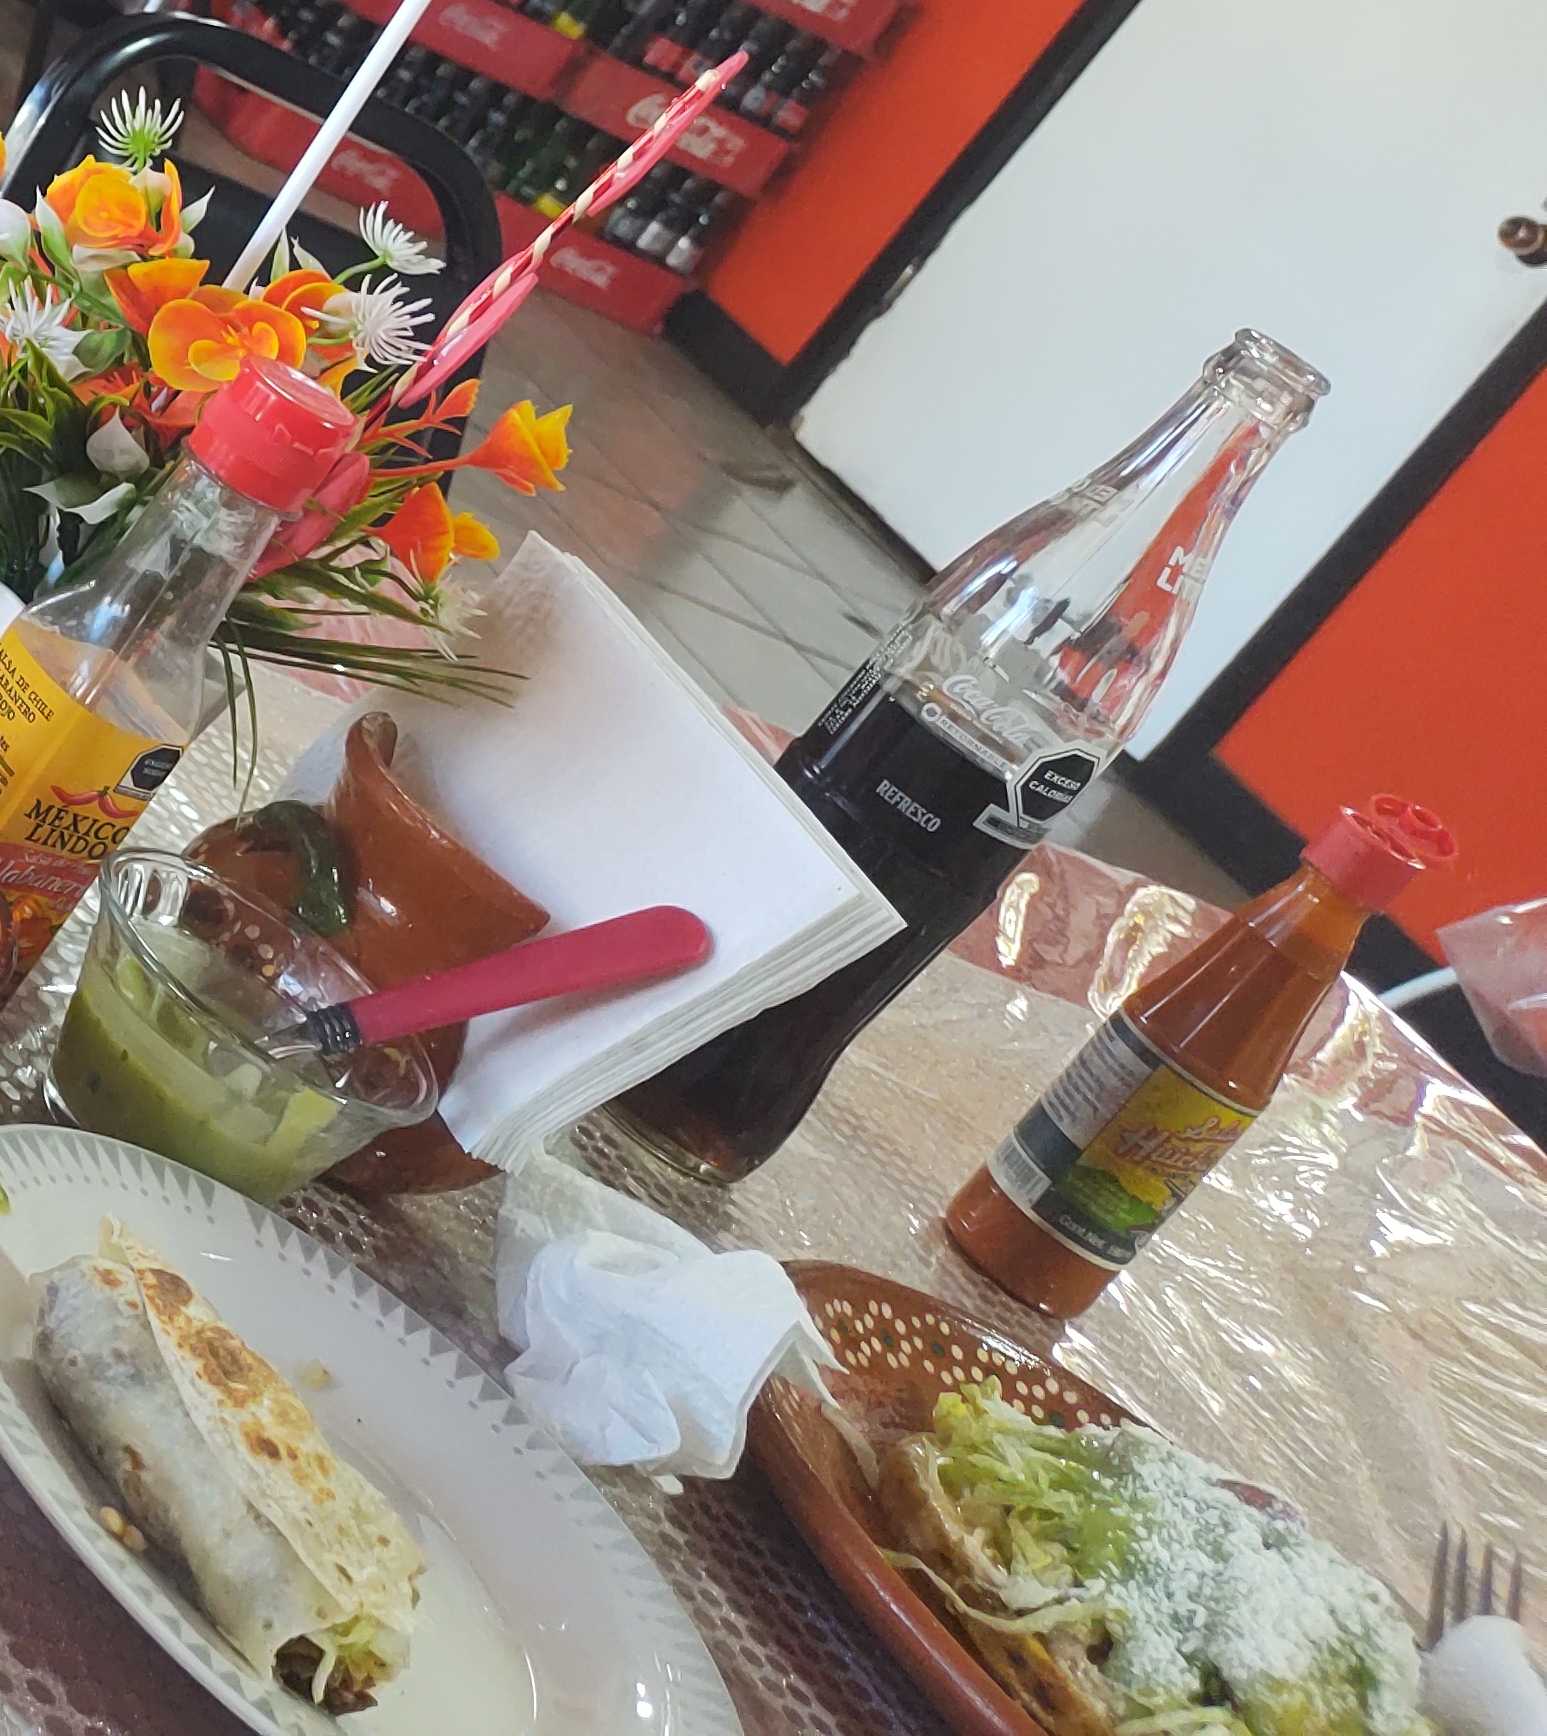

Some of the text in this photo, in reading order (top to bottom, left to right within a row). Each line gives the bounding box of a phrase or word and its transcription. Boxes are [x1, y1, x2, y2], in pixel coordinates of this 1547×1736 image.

[15, 674, 30, 693] DE
[28, 690, 54, 721] CHILE
[23, 798, 130, 845] MÉXICO
[875, 779, 942, 833] REFRESCO
[24, 822, 108, 859] LINDO
